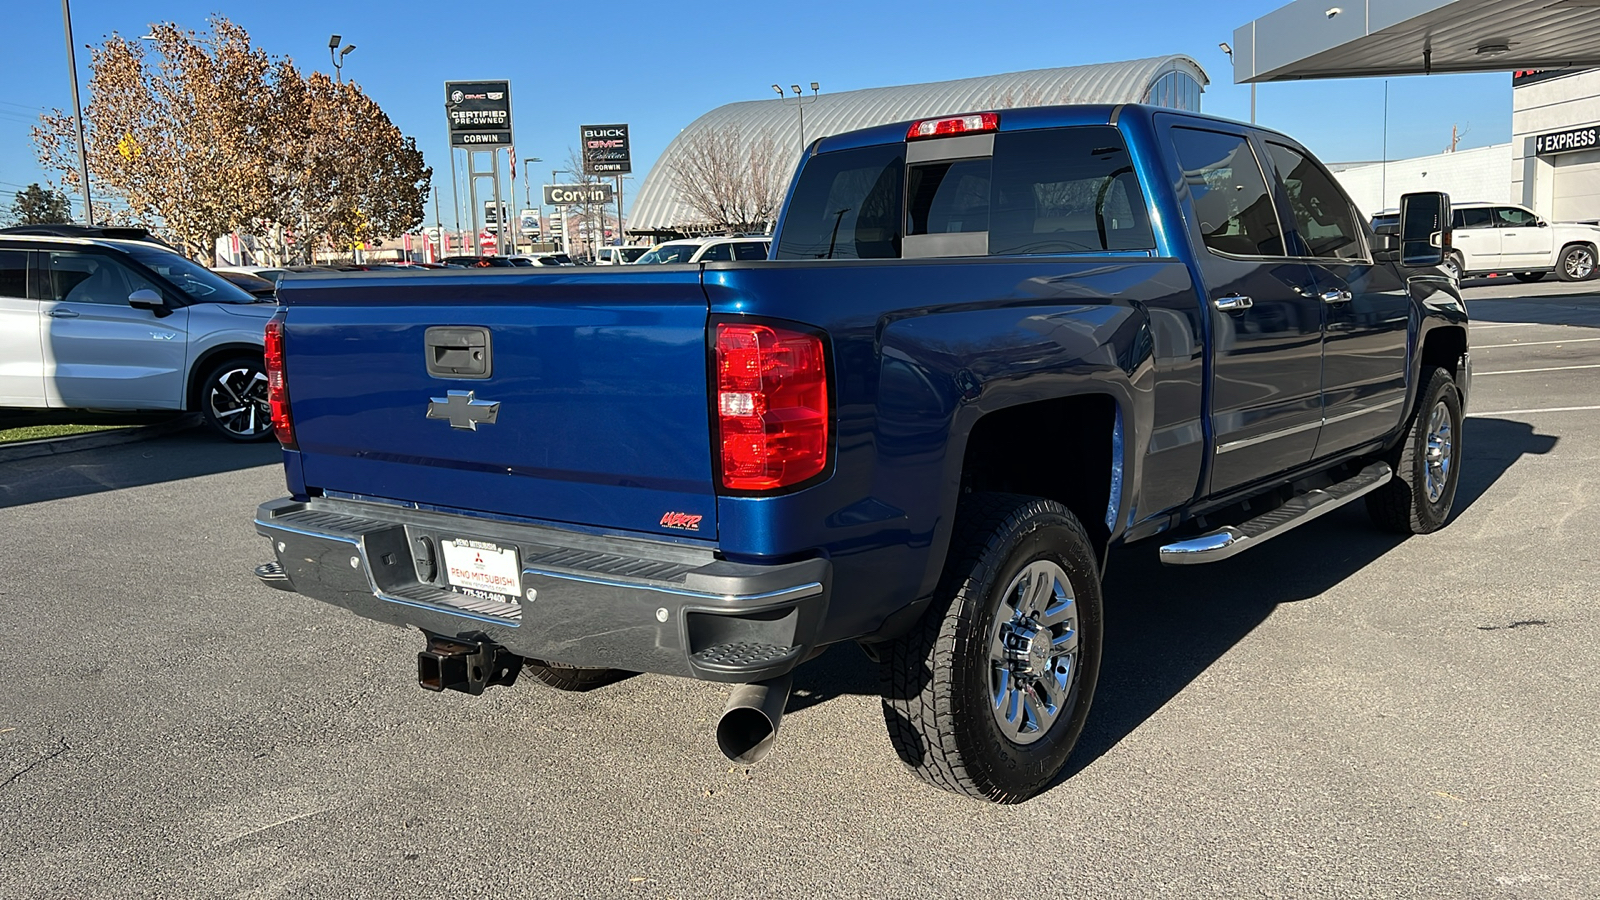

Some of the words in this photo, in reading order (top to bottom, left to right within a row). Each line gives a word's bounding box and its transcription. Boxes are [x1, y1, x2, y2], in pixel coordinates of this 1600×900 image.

[451, 110, 507, 118] CERTIFIED
[463, 134, 498, 143] CORWIN
[584, 129, 625, 137] BUICK
[587, 139, 624, 148] GMC
[1545, 129, 1596, 151] EXPRESS
[551, 187, 604, 202] Corwin
[451, 567, 470, 579] RENO
[471, 572, 515, 587] MITSUBISHI
[462, 588, 506, 603] 775-321-9400
